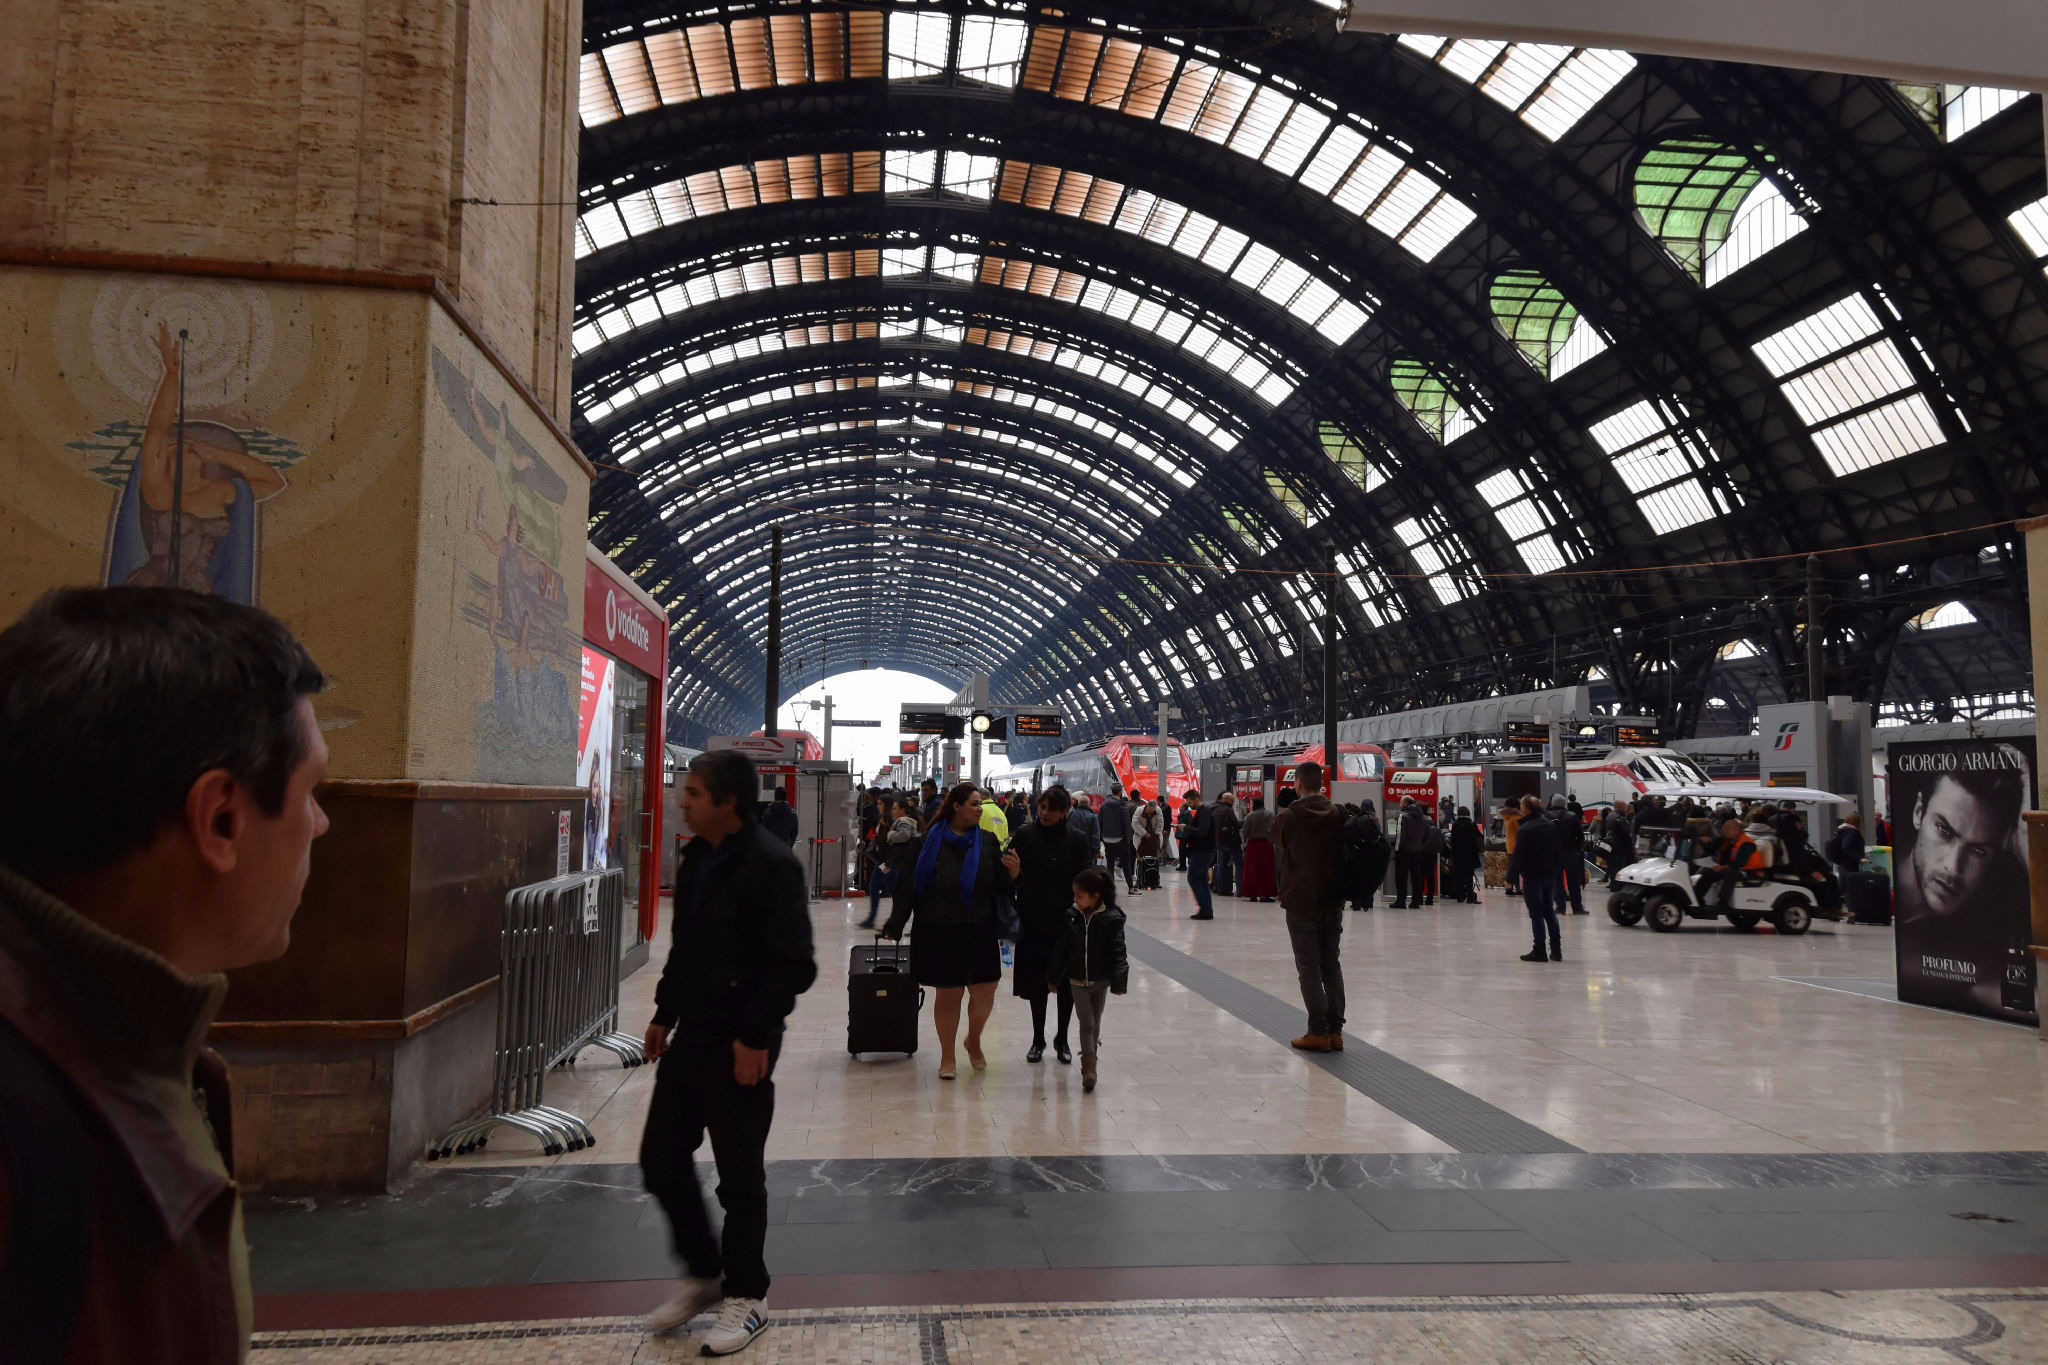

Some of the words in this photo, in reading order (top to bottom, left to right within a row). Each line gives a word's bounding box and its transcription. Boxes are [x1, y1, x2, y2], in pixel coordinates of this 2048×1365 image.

[617, 608, 649, 652] vodafone
[1209, 763, 1222, 773] 13
[1898, 752, 1957, 772] GIORGIO
[1962, 750, 2021, 771] ARMANI
[1545, 771, 1558, 781] 14
[1922, 954, 1976, 975] PROFUMO
